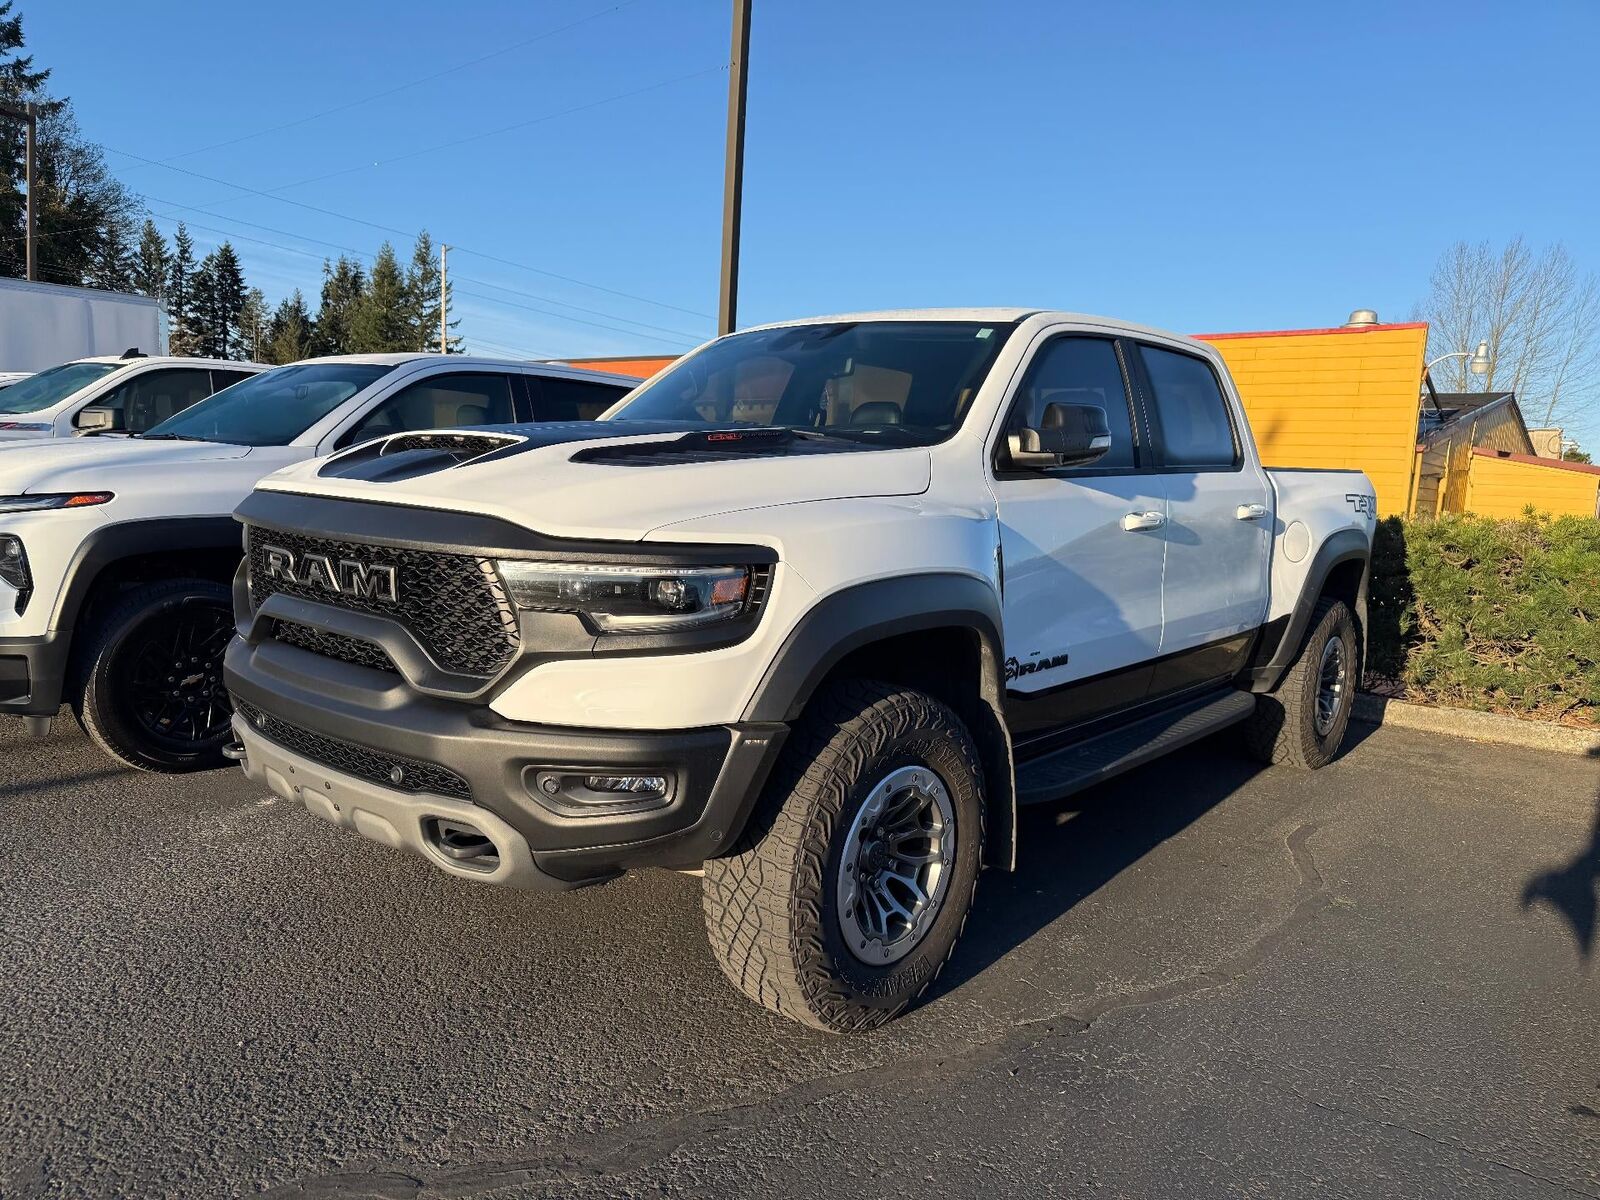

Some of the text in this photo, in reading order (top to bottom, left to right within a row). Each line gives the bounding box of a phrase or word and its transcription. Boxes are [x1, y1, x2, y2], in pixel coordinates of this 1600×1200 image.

[262, 544, 399, 602] RAM
[1019, 654, 1069, 676] RAM
[874, 737, 974, 803] ODYEAR
